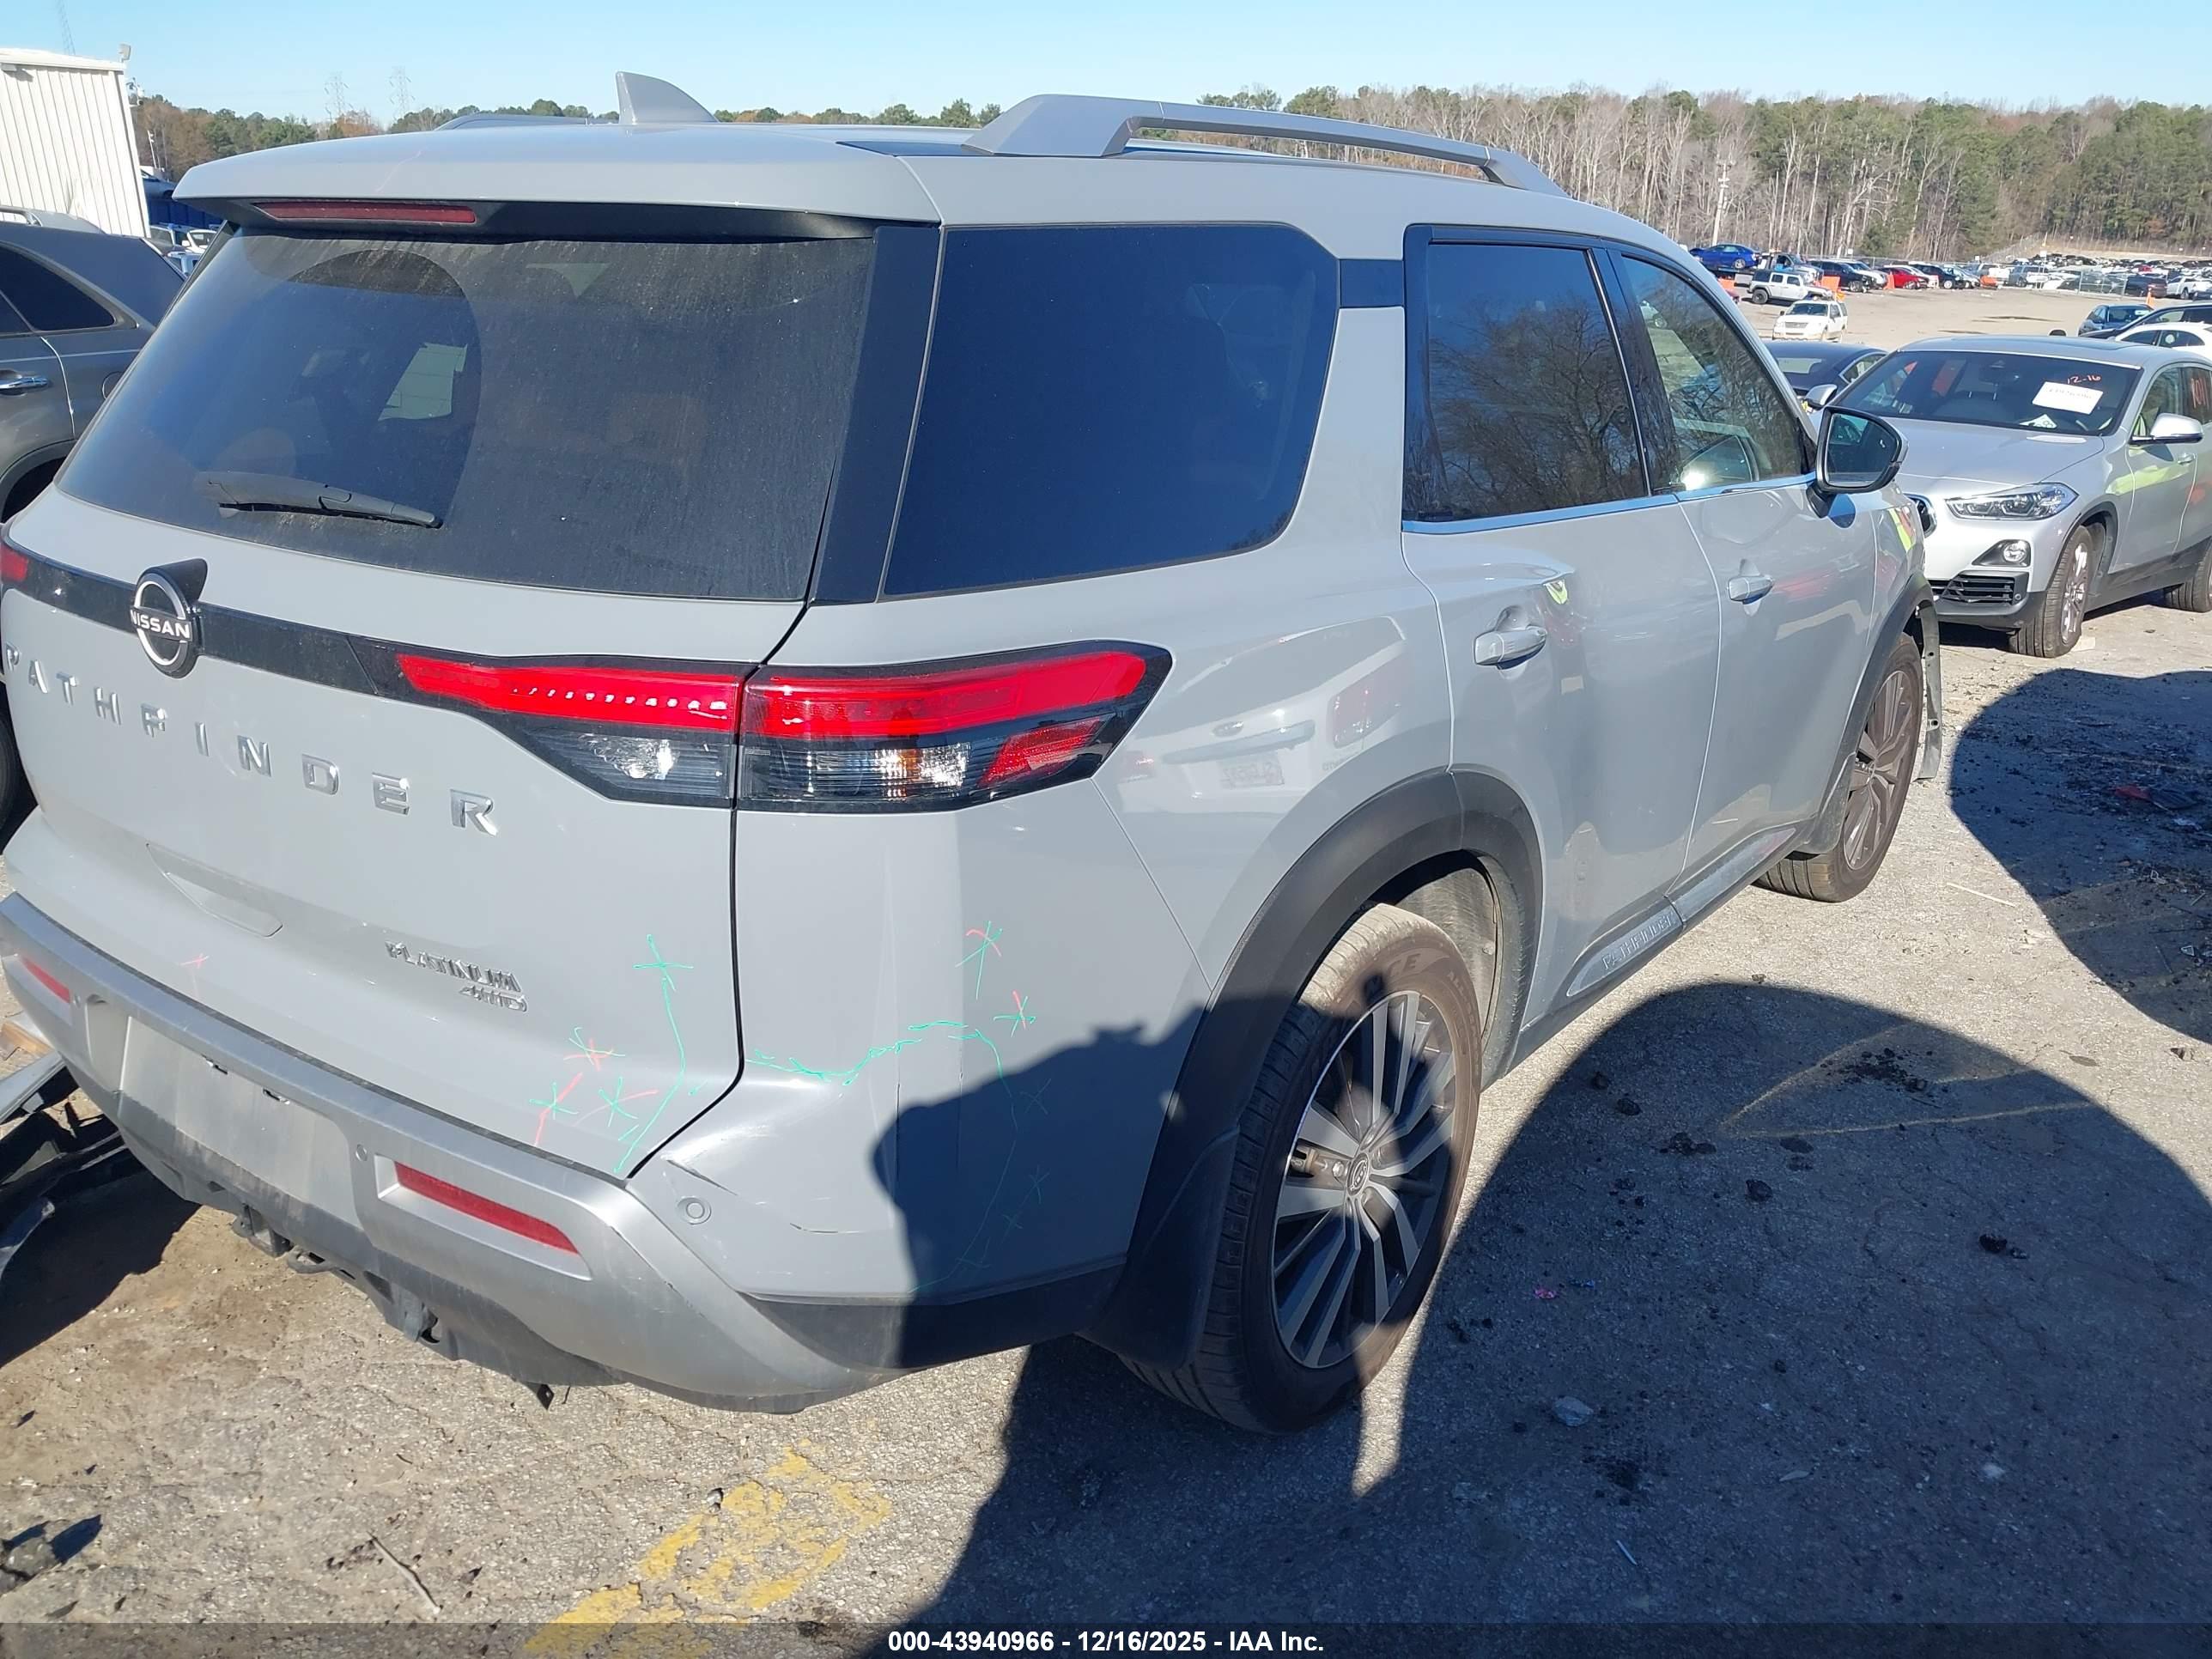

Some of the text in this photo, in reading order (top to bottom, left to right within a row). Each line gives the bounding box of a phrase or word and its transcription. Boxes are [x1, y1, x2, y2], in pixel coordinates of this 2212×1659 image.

[131, 609, 190, 638] NISSAN
[6, 641, 498, 837] PATHFINDER
[386, 940, 521, 993] PLATINUM
[459, 985, 528, 1012] 4WD
